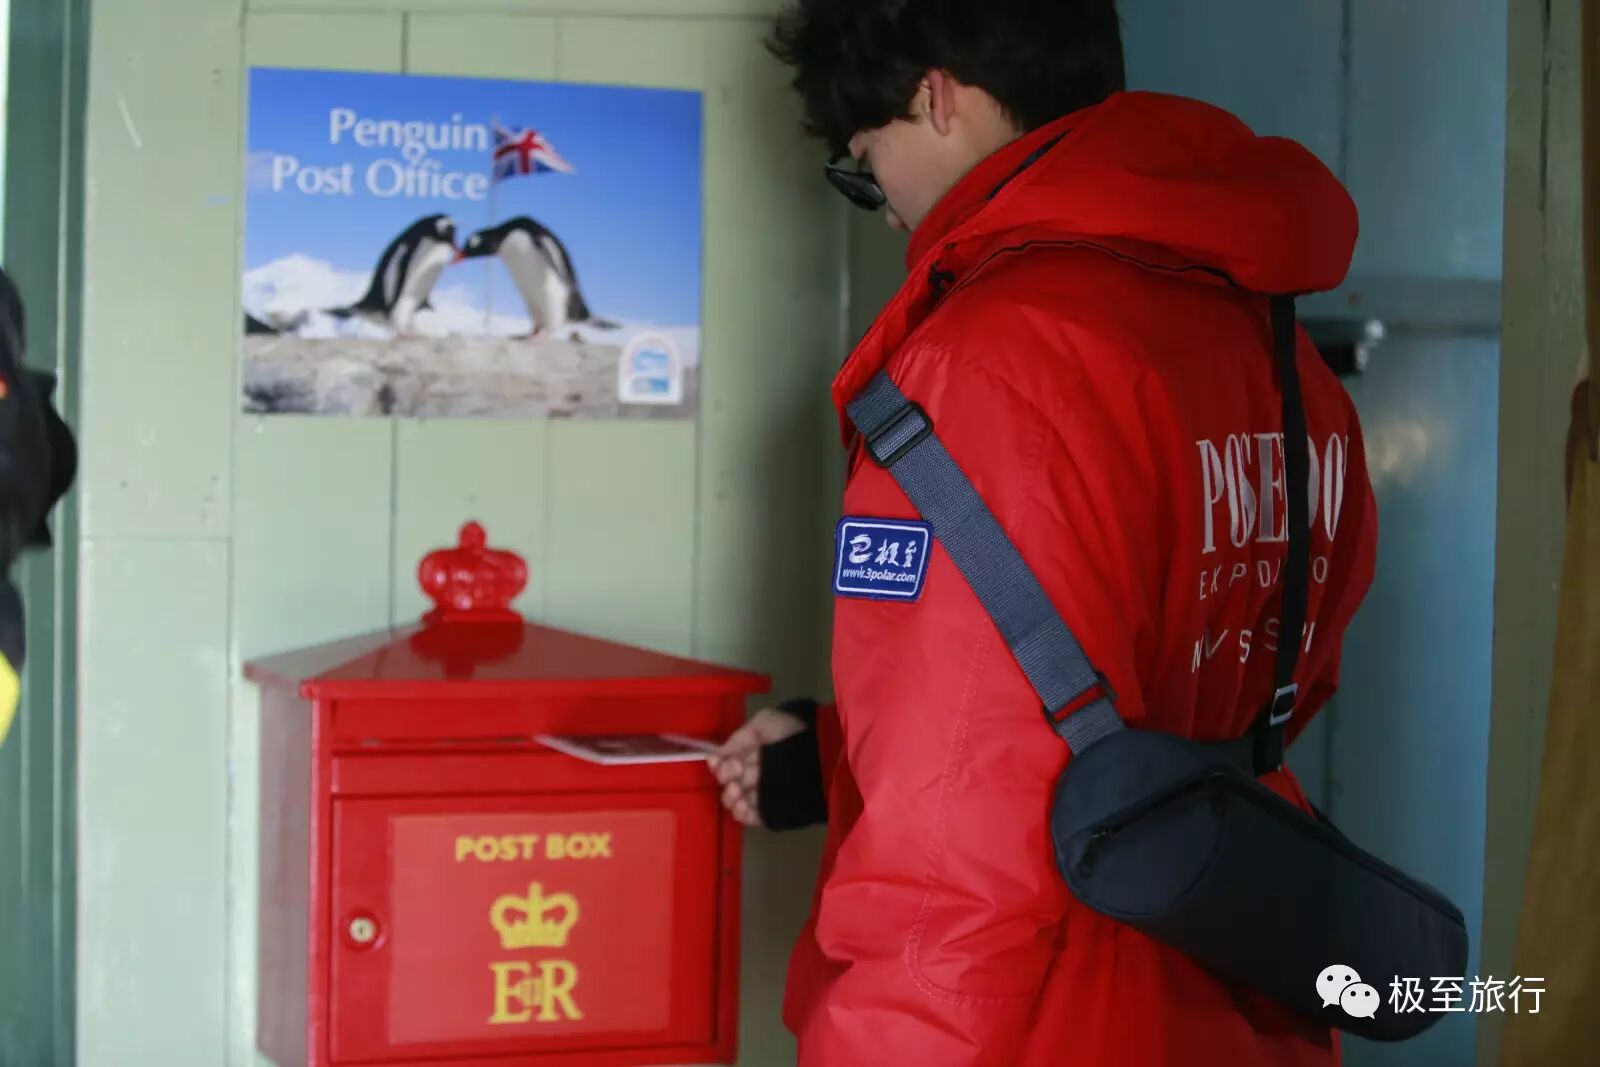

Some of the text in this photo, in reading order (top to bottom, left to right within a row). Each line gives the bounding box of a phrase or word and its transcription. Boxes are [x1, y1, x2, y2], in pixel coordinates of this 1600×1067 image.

[329, 107, 488, 162] Penguin
[272, 155, 489, 201] Post Office
[842, 565, 917, 584] www.3polar.com
[455, 832, 613, 863] POST BOX
